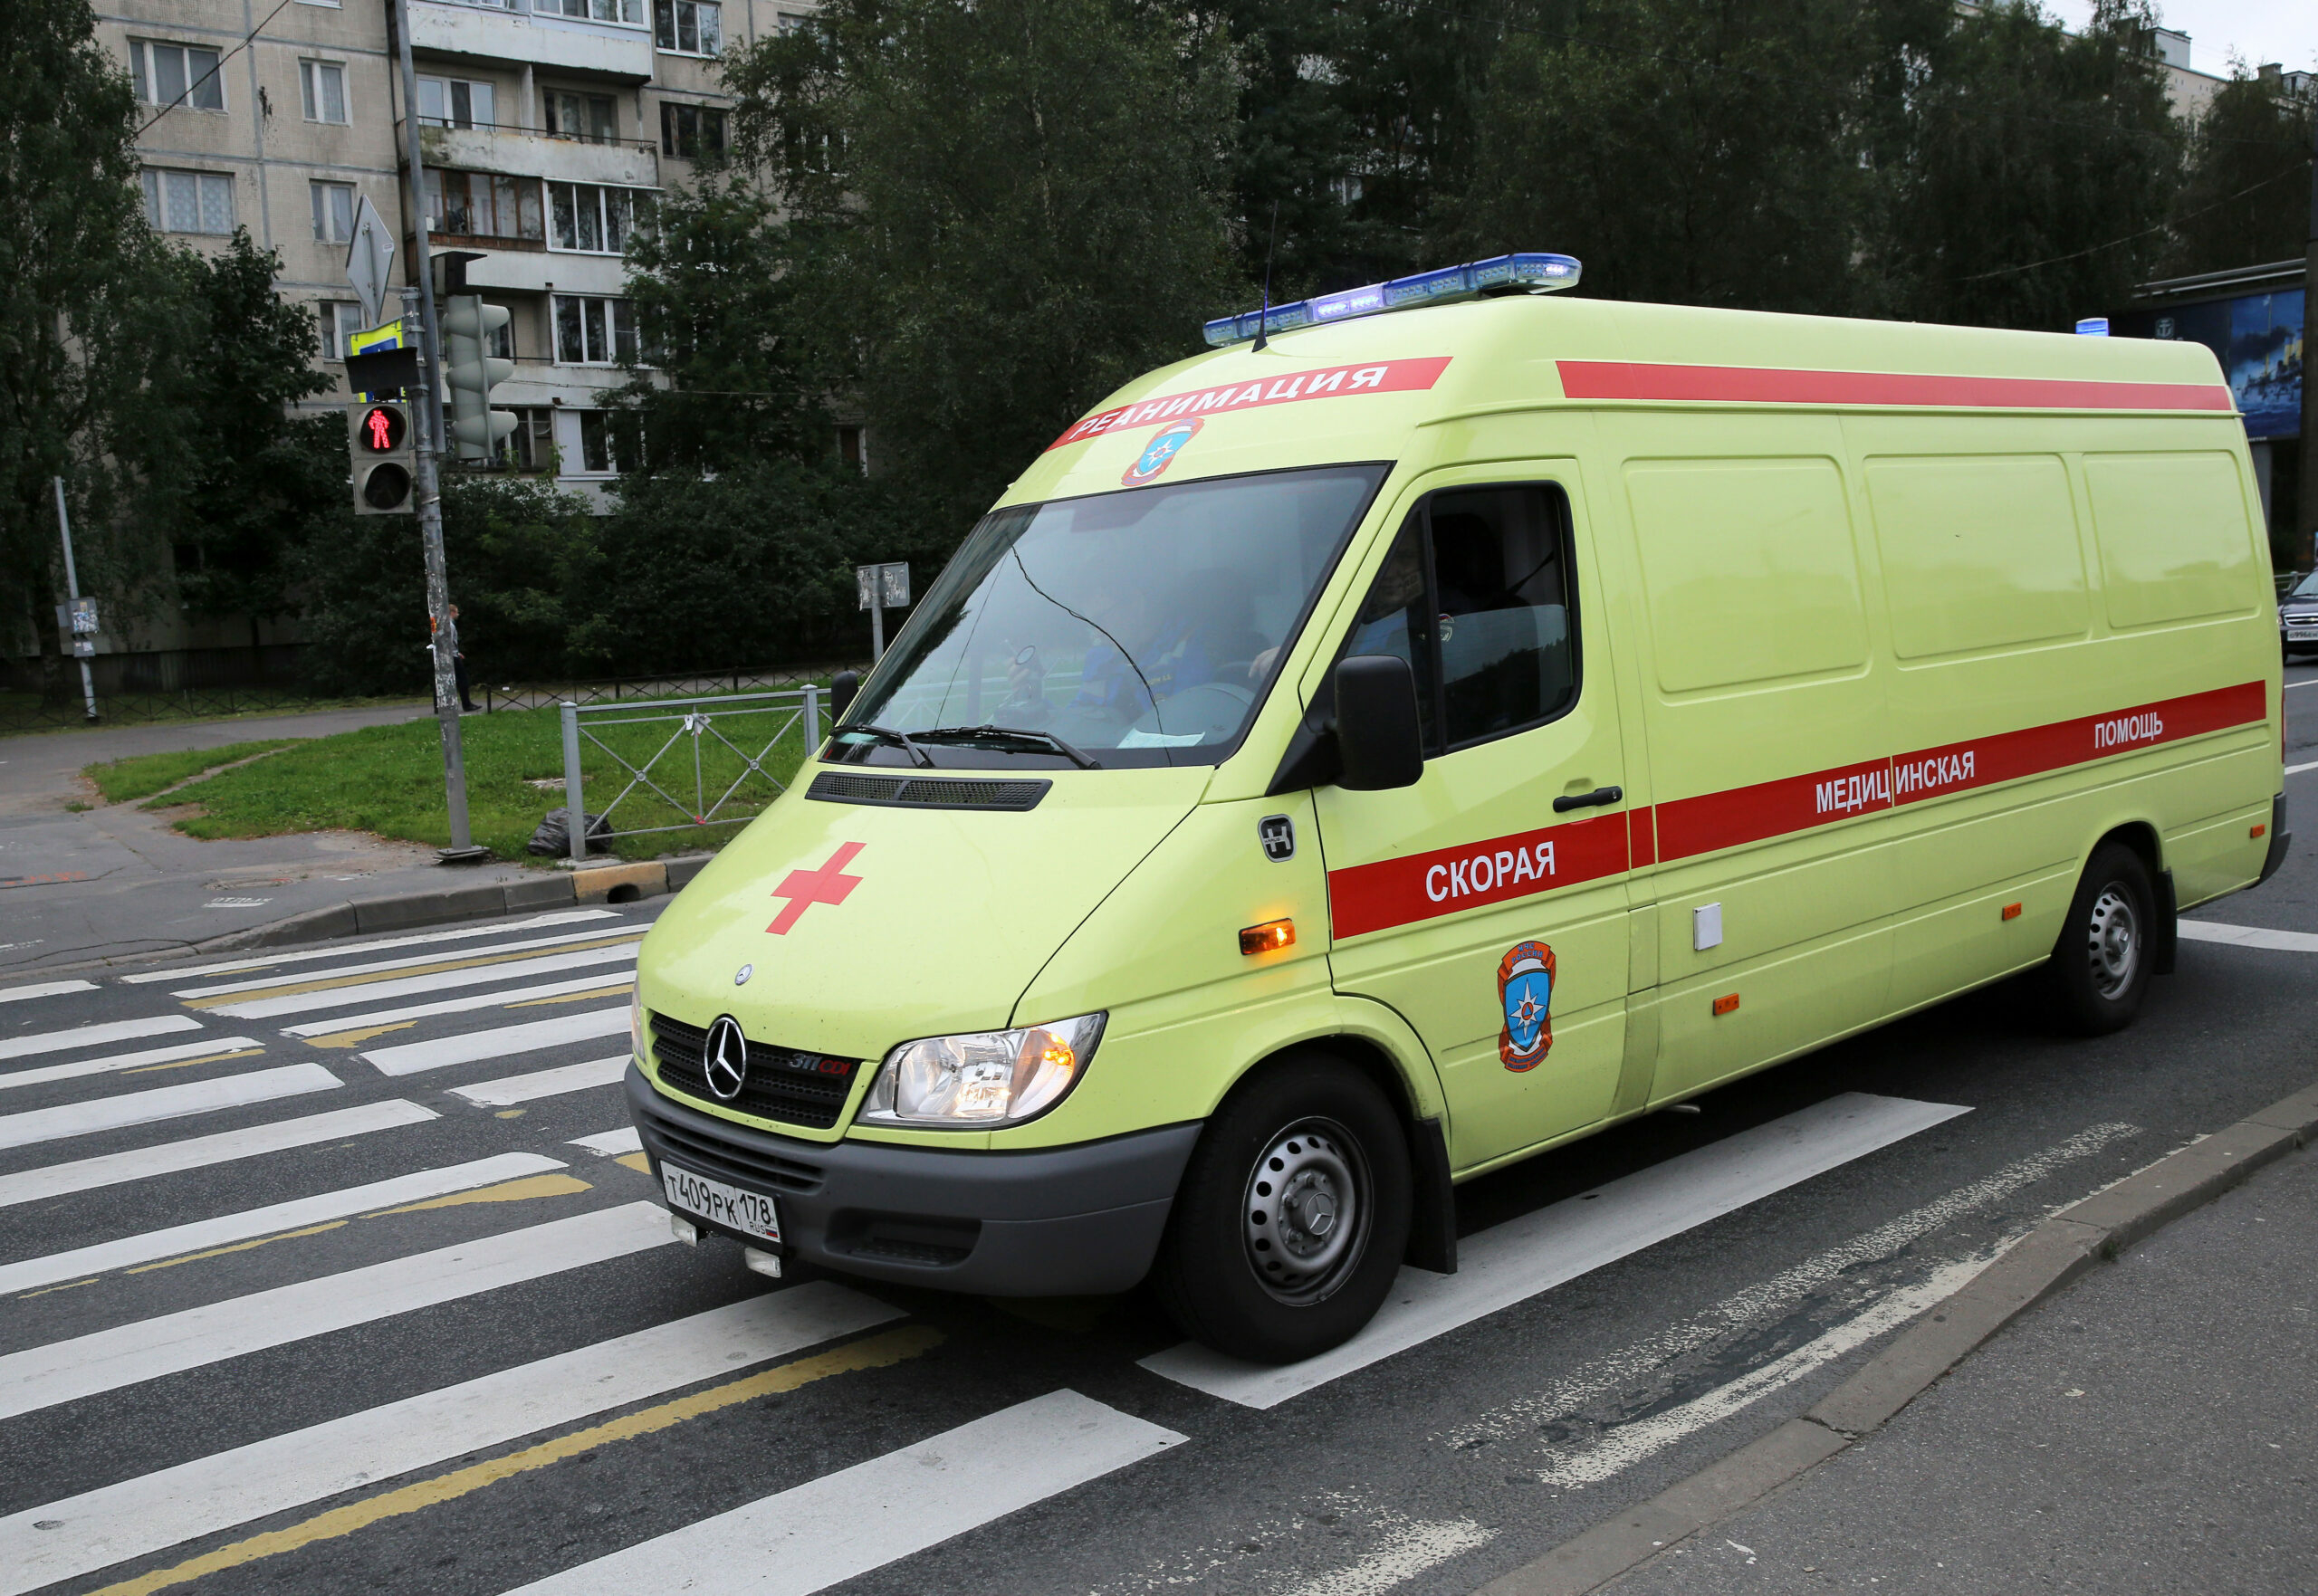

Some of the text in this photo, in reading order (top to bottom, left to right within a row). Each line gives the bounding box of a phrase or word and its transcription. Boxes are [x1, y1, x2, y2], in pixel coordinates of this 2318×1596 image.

[1068, 366, 1389, 440] РЕАНИМАЦИЯ
[1425, 712, 2163, 903] СКОРАЯ МЕДИЦИНСКАЯ ПОМОЩЬ
[749, 1221, 766, 1235] RUS
